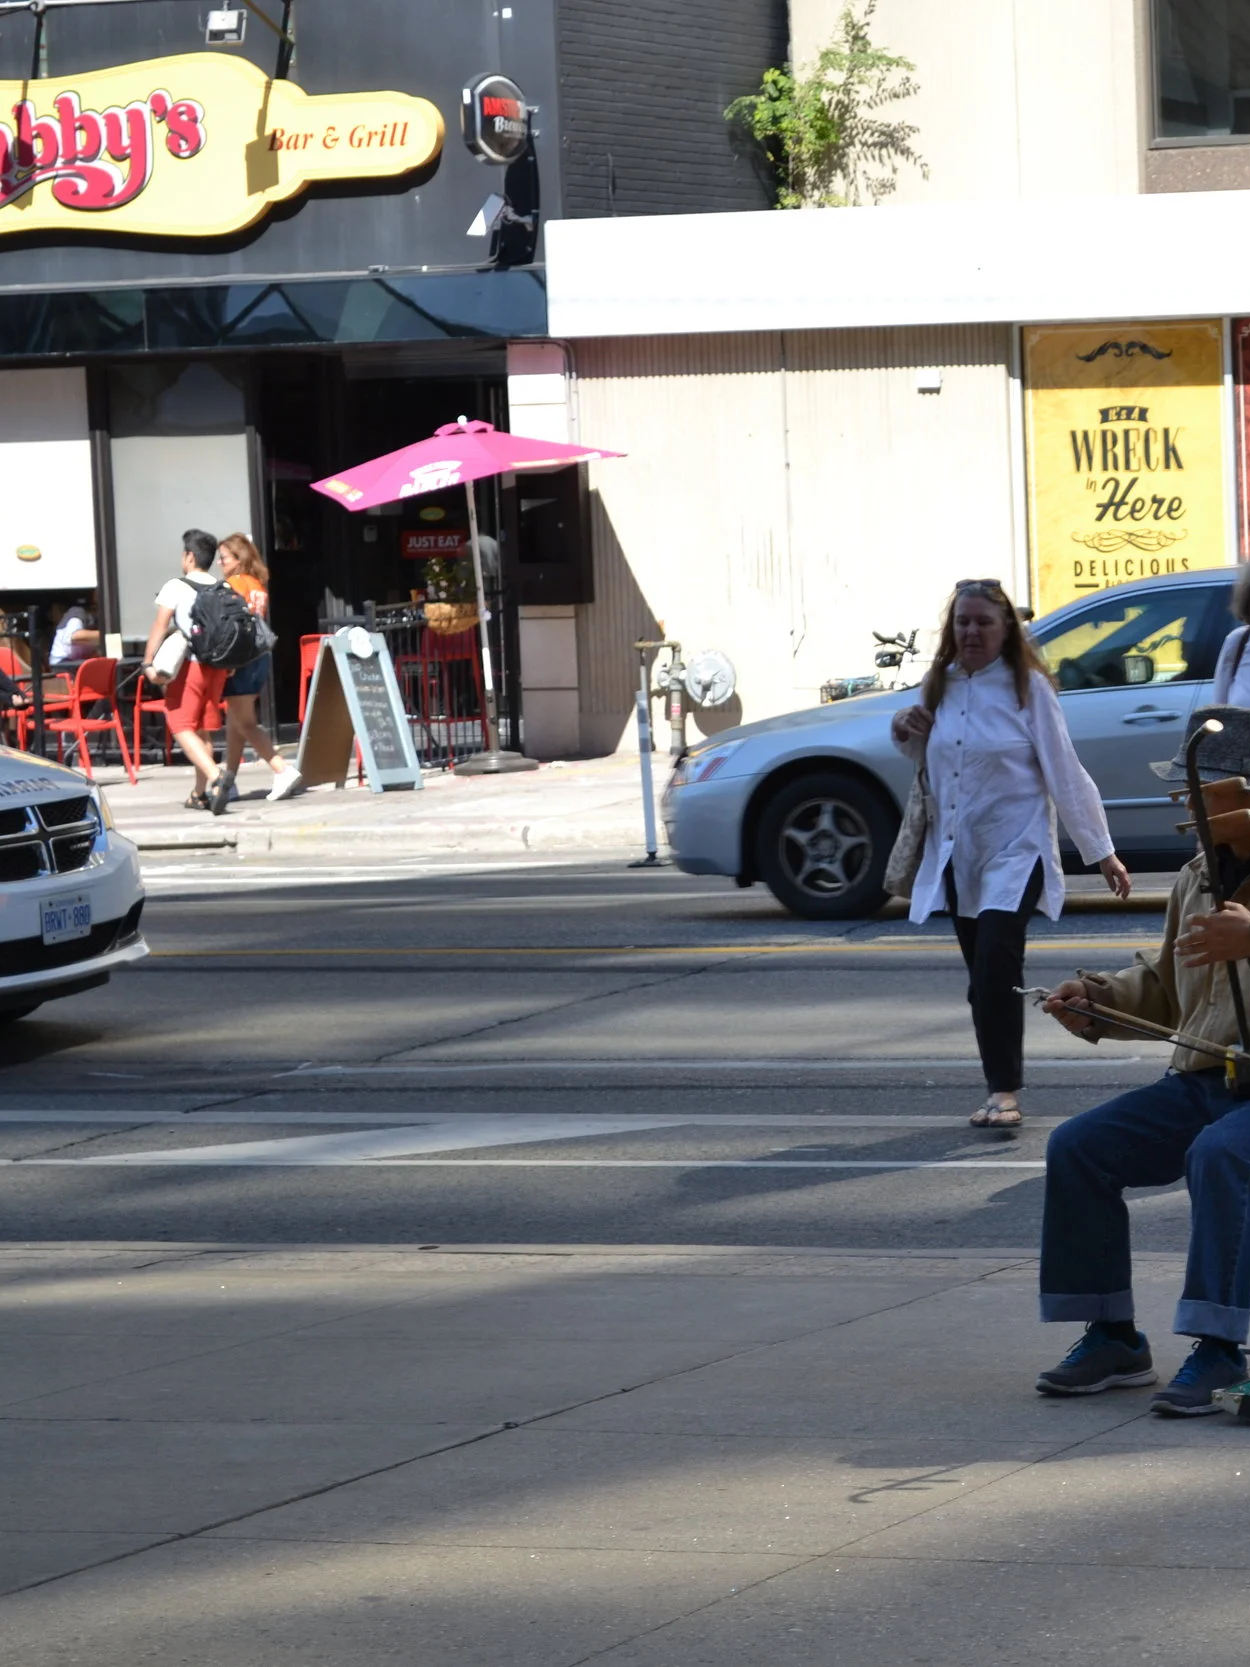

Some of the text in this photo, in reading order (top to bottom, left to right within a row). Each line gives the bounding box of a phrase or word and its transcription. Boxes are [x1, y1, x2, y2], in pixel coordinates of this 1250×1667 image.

[267, 122, 410, 152] Bar & Grill
[1070, 427, 1184, 472] WRECK
[1094, 476, 1186, 522] Here
[407, 535, 460, 548] JUST EAT
[1074, 558, 1190, 577] DELICIOUS
